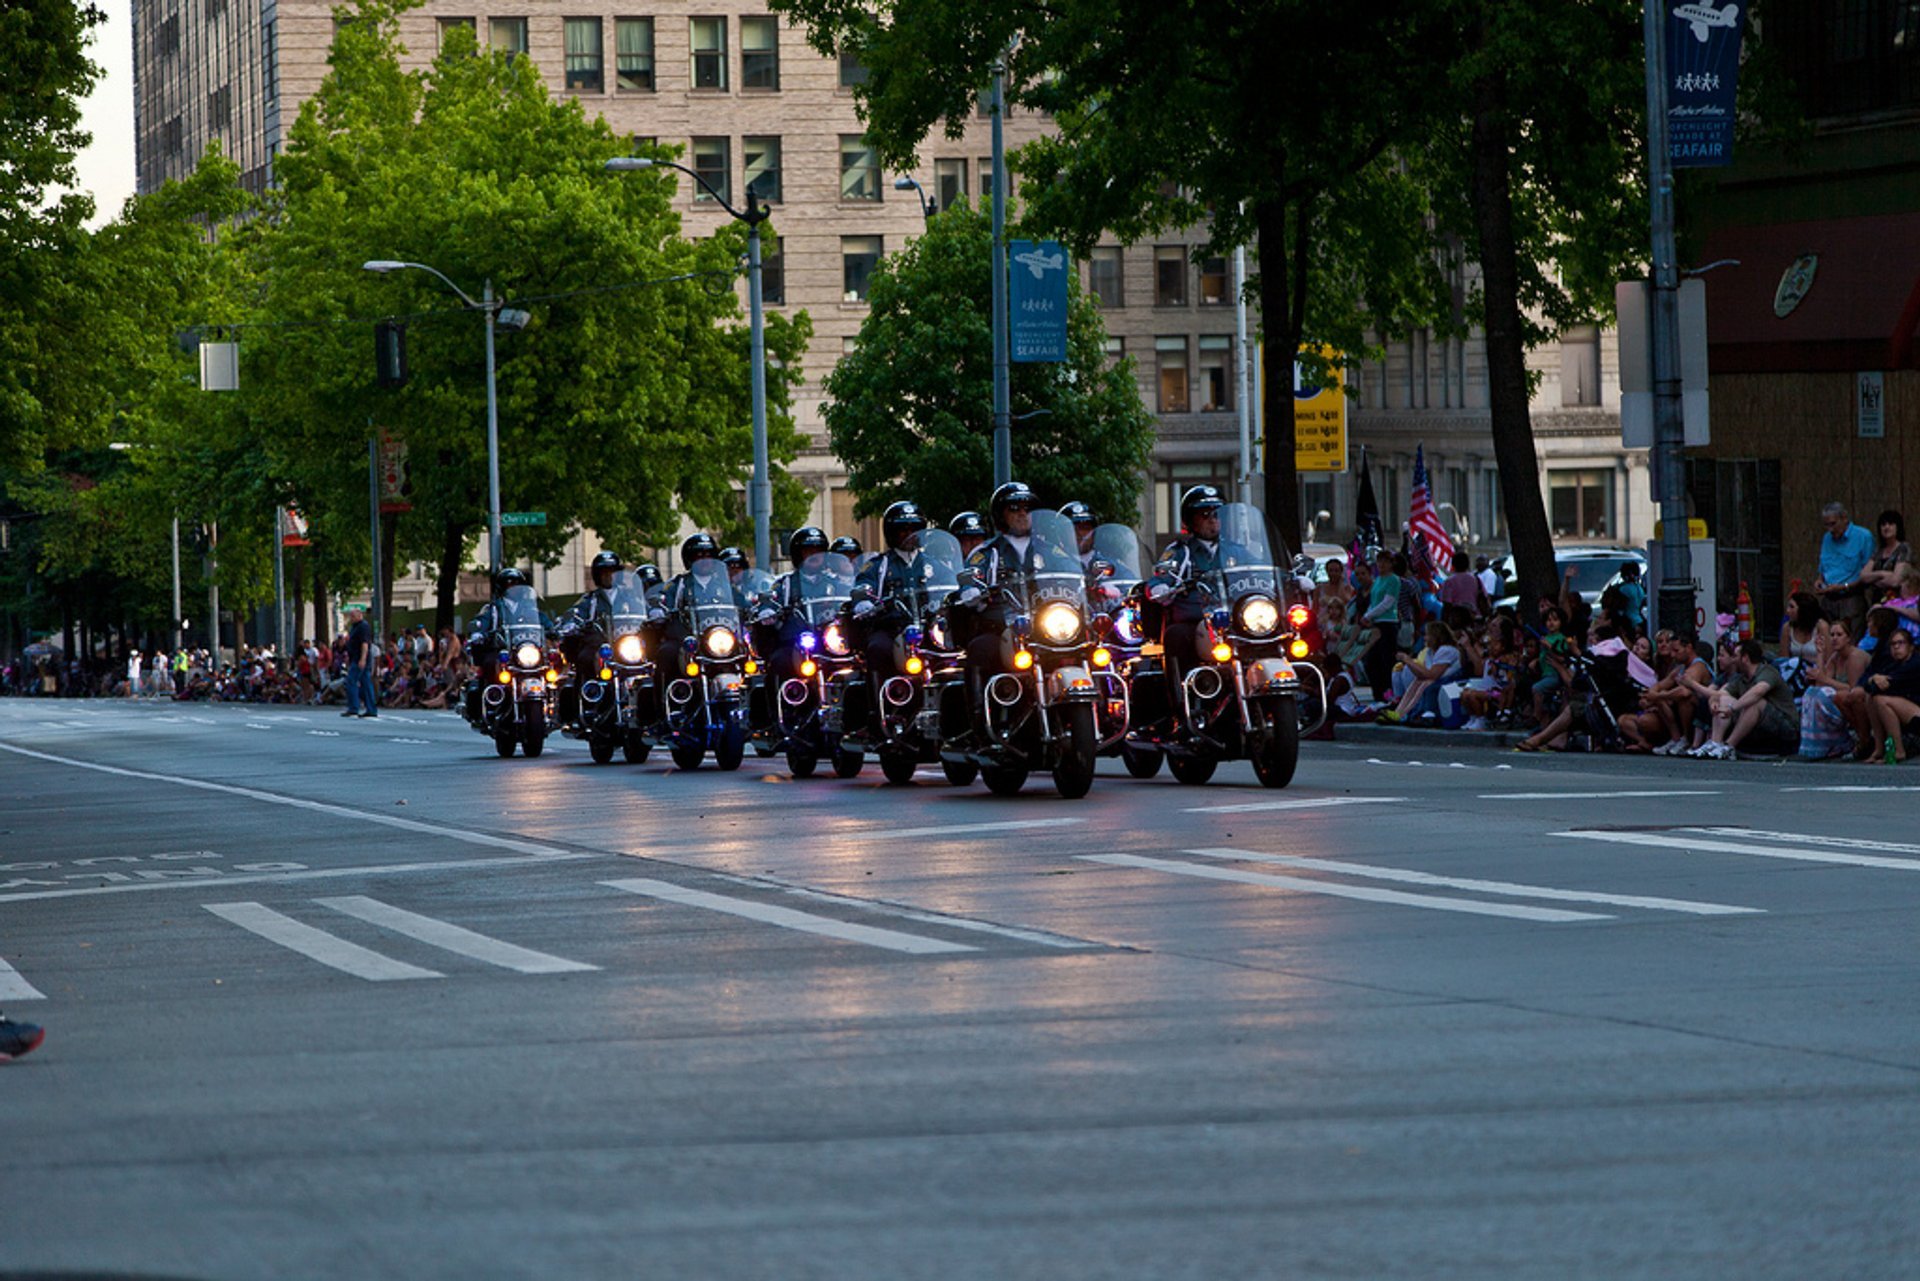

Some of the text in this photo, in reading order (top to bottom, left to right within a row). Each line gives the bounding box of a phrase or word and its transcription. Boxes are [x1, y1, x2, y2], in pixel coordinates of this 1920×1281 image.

[1669, 122, 1727, 131] ORCHLIGHT
[1016, 345, 1059, 355] SEAFAIR
[1228, 577, 1276, 600] POLICE
[1032, 587, 1081, 610] POLICE
